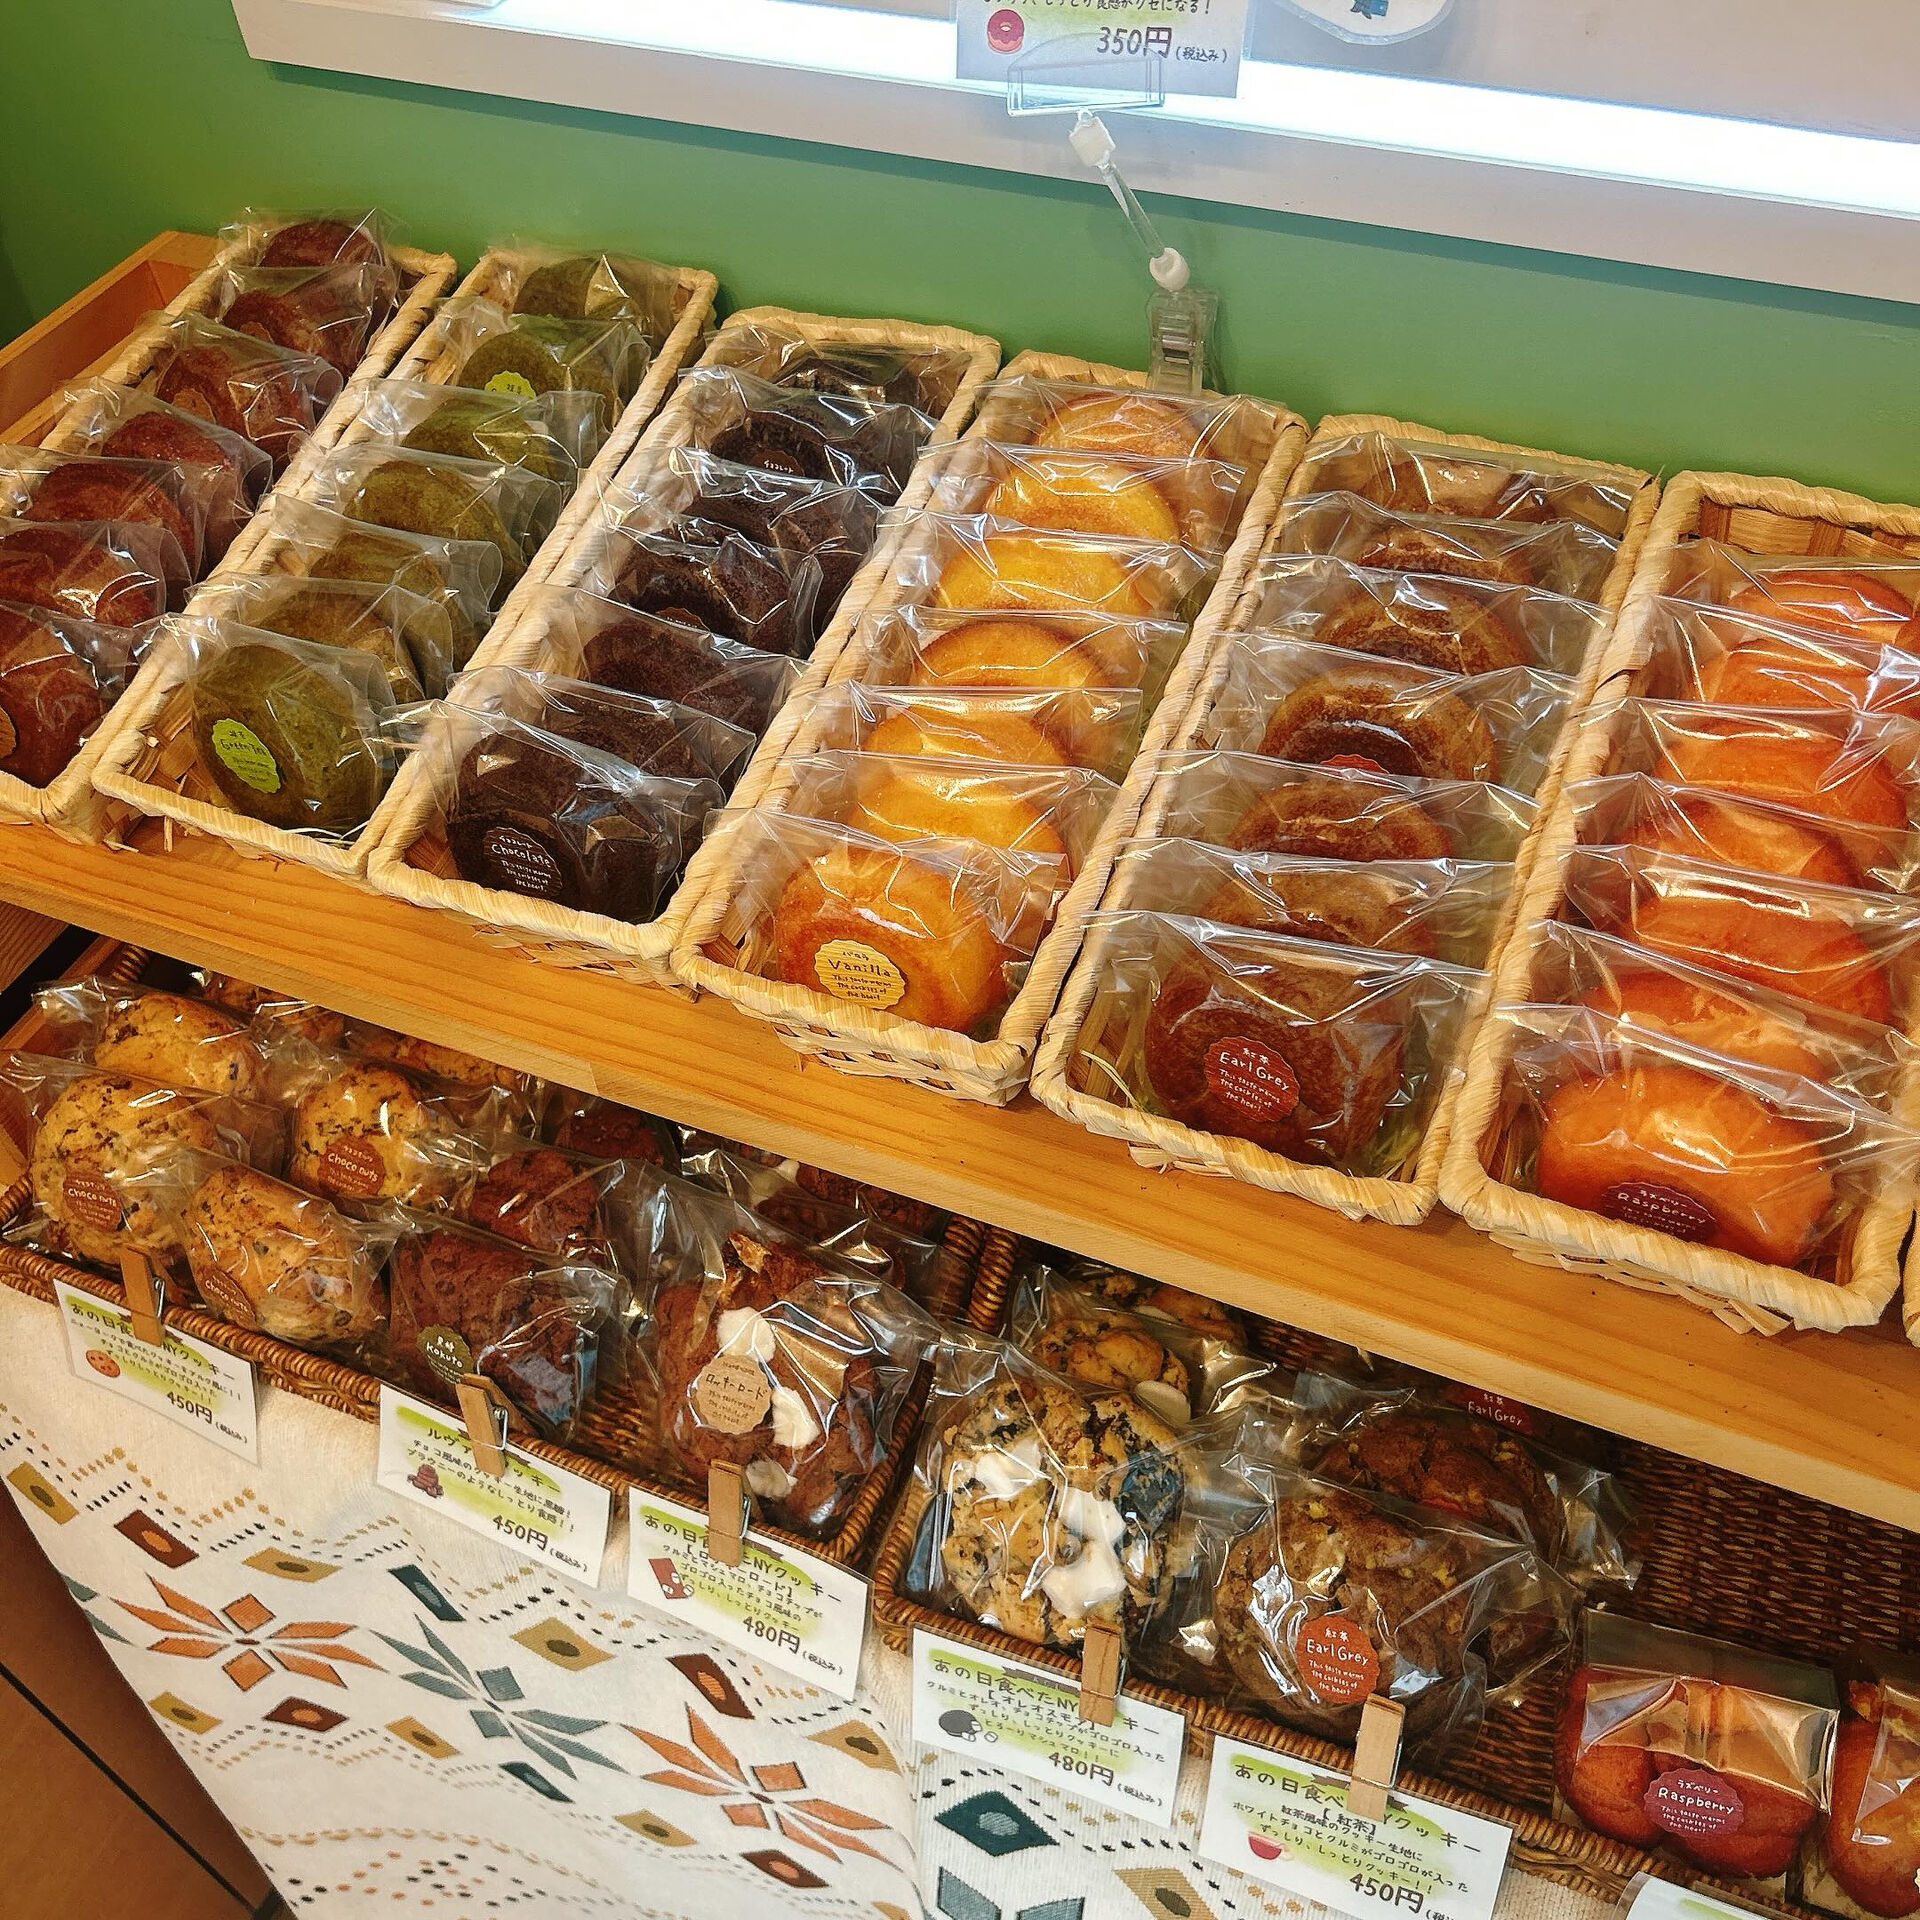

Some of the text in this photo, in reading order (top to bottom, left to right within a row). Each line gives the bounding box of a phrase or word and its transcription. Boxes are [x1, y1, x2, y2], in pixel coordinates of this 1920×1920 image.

[1097, 26, 1172, 58] 350円
[491, 844, 552, 868] Chocolate
[828, 958, 891, 977] Vanilla
[1220, 1051, 1290, 1091] Earl Grey
[1618, 1192, 1706, 1223] Raspberry
[71, 1301, 235, 1382] あの日食NYクッキー
[706, 1373, 768, 1400] ロッキーロード
[167, 1391, 213, 1424] 450円
[1468, 1401, 1523, 1426] Earl Grey
[427, 1426, 560, 1495] ルヴァッキー
[493, 1515, 548, 1552] 450円
[644, 1512, 842, 1605] あの日たNYクッキー
[743, 1616, 800, 1654] 480円
[1325, 1627, 1349, 1642] 紅茶
[1307, 1638, 1368, 1666] Earl Grey
[934, 1654, 1159, 1740] あの日食べたNYキー
[1049, 1752, 1114, 1786] 480円
[1658, 1787, 1734, 1815] Raspberry
[1677, 1779, 1719, 1794] ラズベリー
[1234, 1761, 1482, 1856] あの日食べYクッキー
[1281, 1805, 1423, 1862] 紅茶風味のクッキー生地に
[1350, 1873, 1423, 1913] 450円
